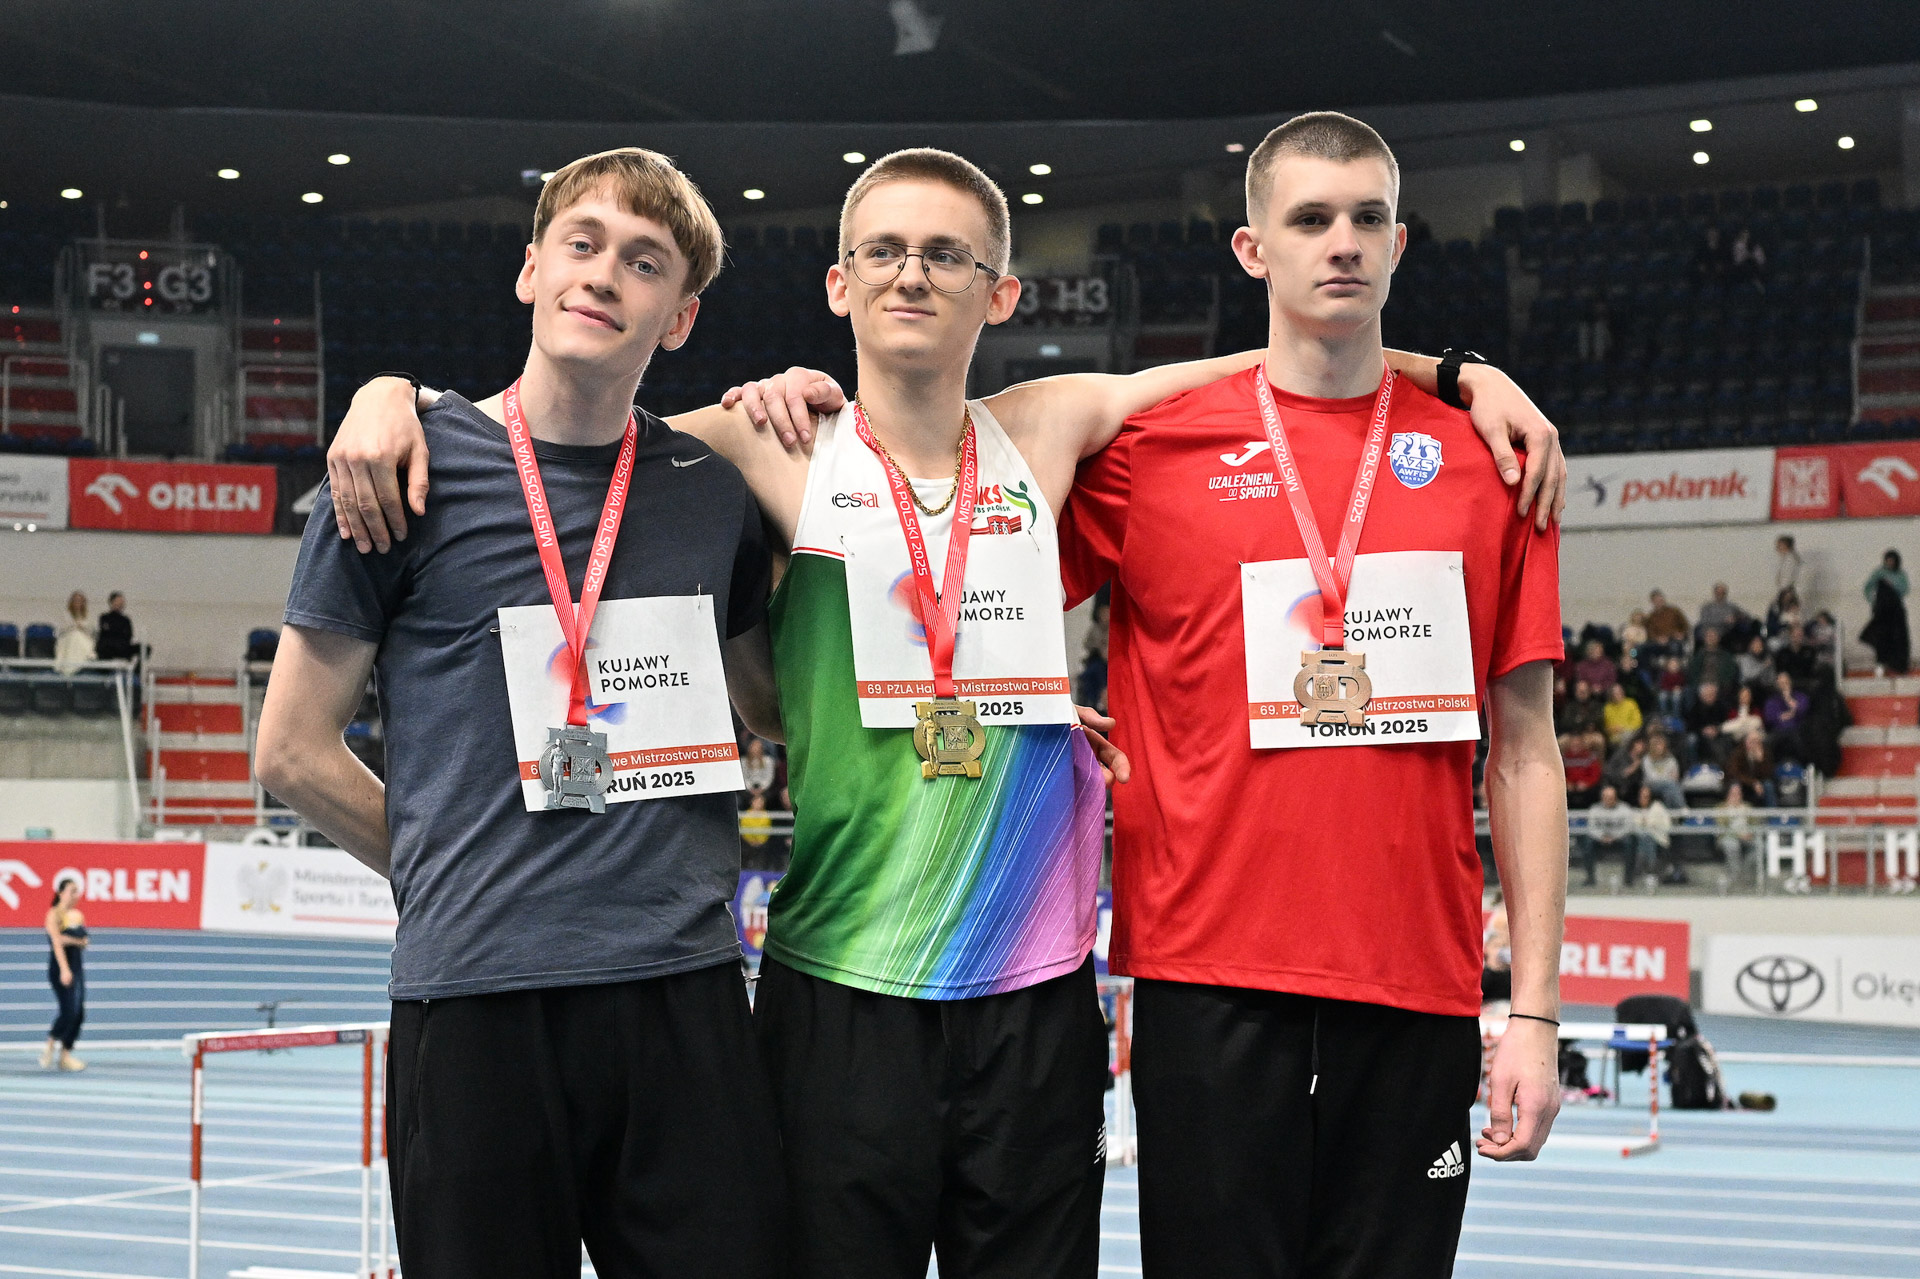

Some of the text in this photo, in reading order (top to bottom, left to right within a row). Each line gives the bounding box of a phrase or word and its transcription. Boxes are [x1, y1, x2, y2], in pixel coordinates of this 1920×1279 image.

[88, 262, 212, 302] F3 G3
[506, 394, 526, 443] POLSKI
[1263, 404, 1300, 493] MISTRZOSTWA
[1395, 454, 1435, 472] AZS
[958, 435, 975, 524] MISTRZOSTWA
[1208, 472, 1274, 490] UZALEŻNIENI
[1358, 443, 1380, 490] POLSKI
[148, 481, 262, 511] ORLEN
[517, 443, 554, 548] MISTRZOSTWA
[1239, 485, 1279, 500] SPORTU
[1620, 470, 1749, 509] polanik
[1350, 492, 1368, 524] 2025
[595, 507, 618, 558] POLSKI
[896, 490, 929, 577] POLSKI 2025
[586, 559, 604, 592] 2025
[936, 589, 1006, 605] KJAWY
[957, 607, 1025, 622] MORZE
[598, 655, 669, 674] KUJAWY
[601, 672, 690, 693] POMORZE
[867, 680, 1064, 694] 69. PZLA Hale Mistrzostwa Polski
[979, 701, 1024, 716] 2025
[1260, 697, 1471, 716] 69. PZL Mistrzostwa Polski
[1380, 719, 1429, 735] 2025
[630, 749, 699, 765] Mistrzostwa
[701, 745, 733, 759] Polski
[606, 771, 647, 793] RUŃ
[650, 770, 695, 789] 2025
[1768, 829, 1826, 878] H1
[1559, 942, 1666, 982] RLEN
[1851, 971, 1920, 1007] Okę
[1427, 1162, 1465, 1179] adidas
